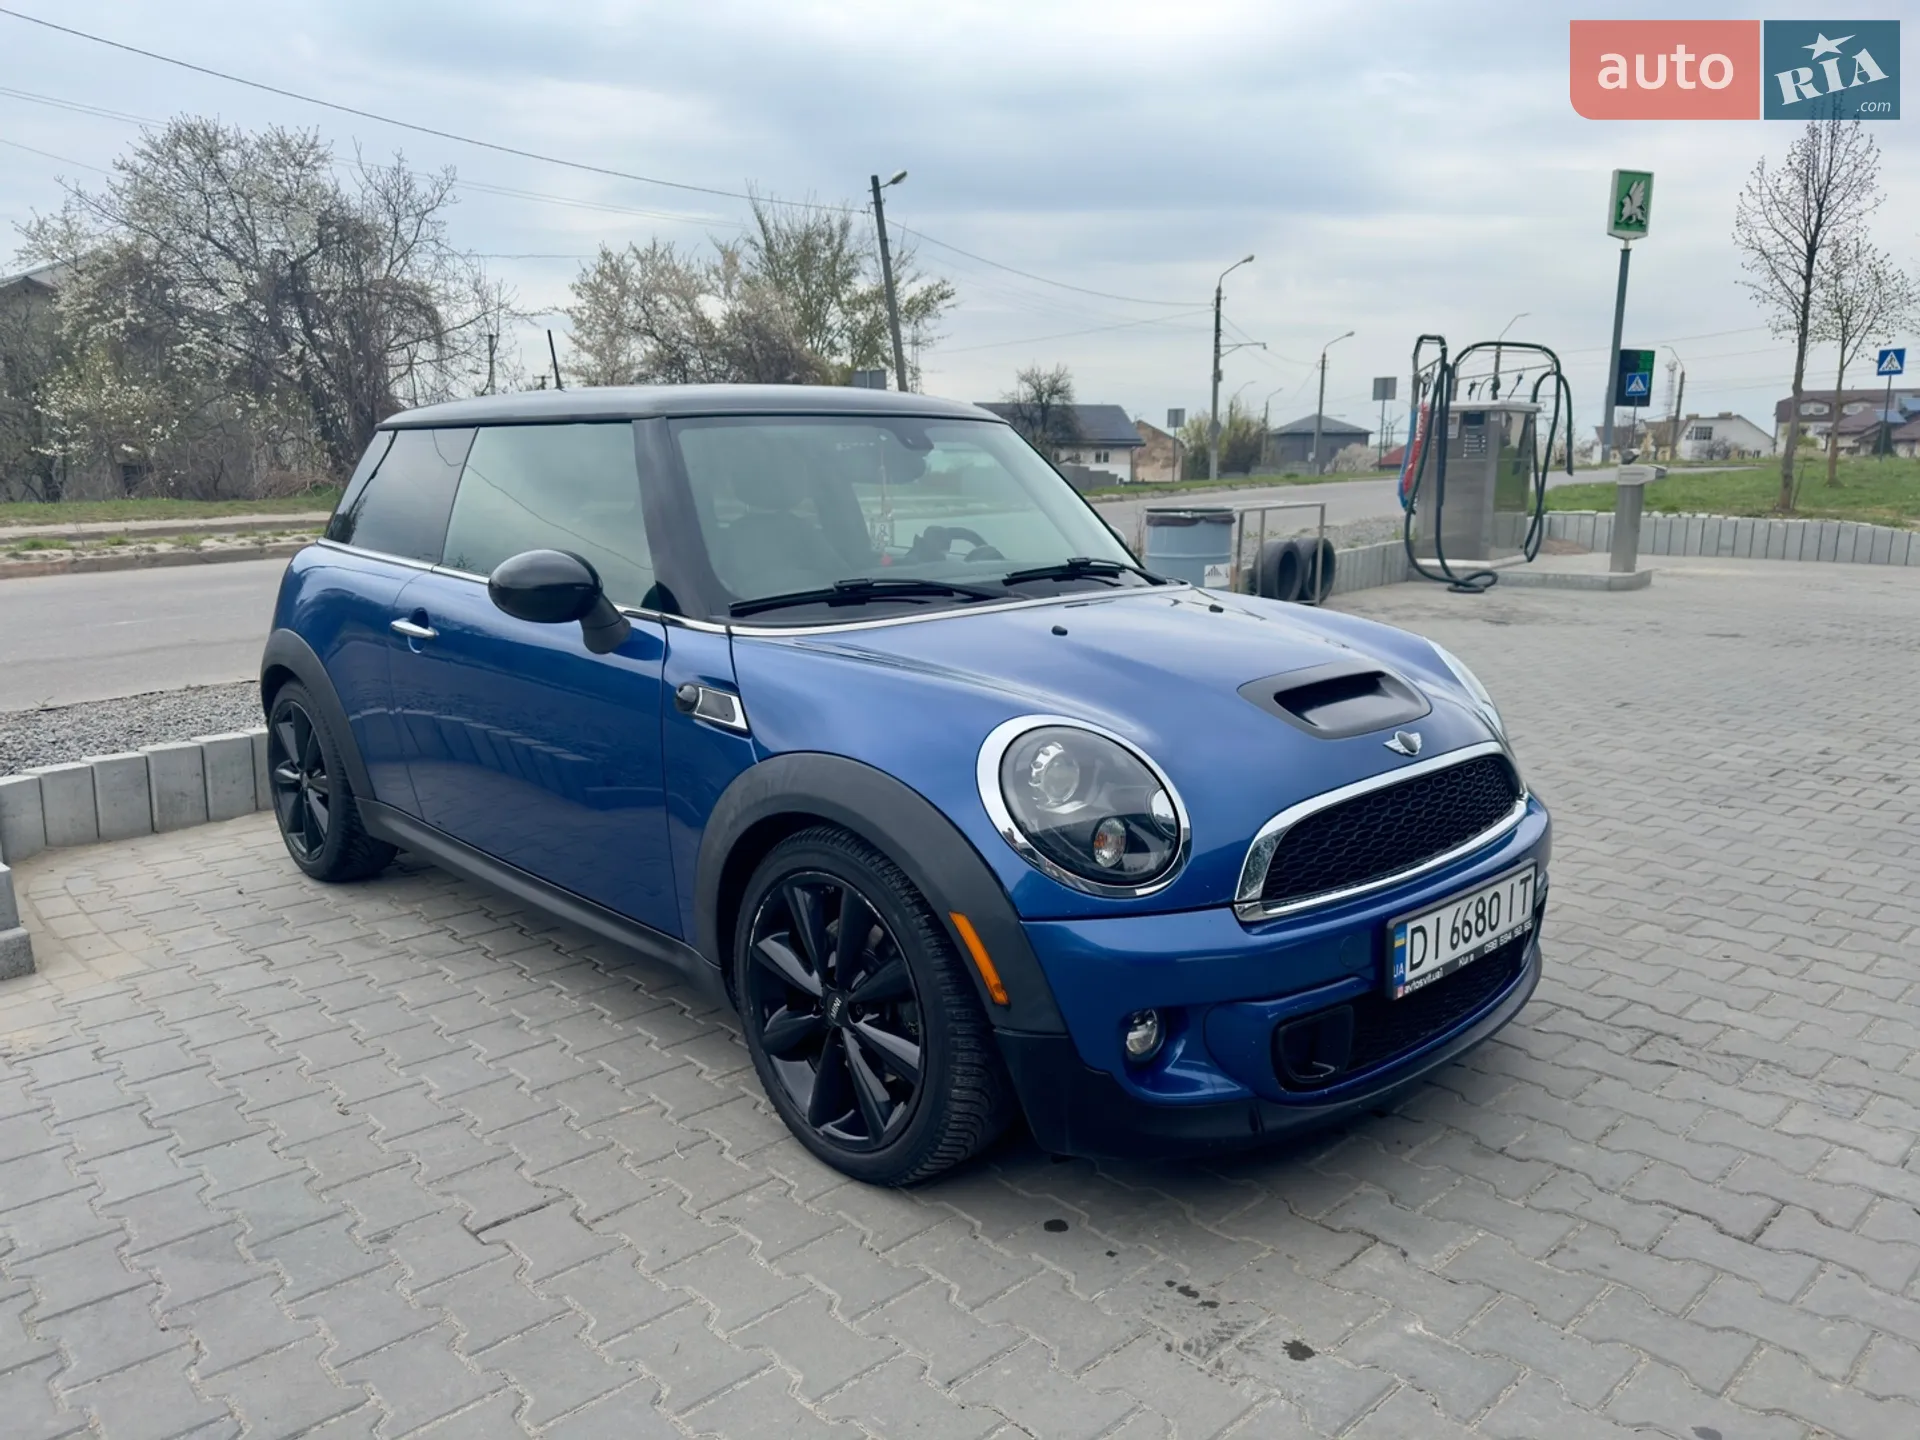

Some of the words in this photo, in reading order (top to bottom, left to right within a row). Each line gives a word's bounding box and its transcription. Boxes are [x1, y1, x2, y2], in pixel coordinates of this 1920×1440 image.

[1409, 916, 1441, 972] DI
[1450, 890, 1500, 951] 6680
[1508, 874, 1532, 923] IT
[1393, 962, 1405, 978] UA
